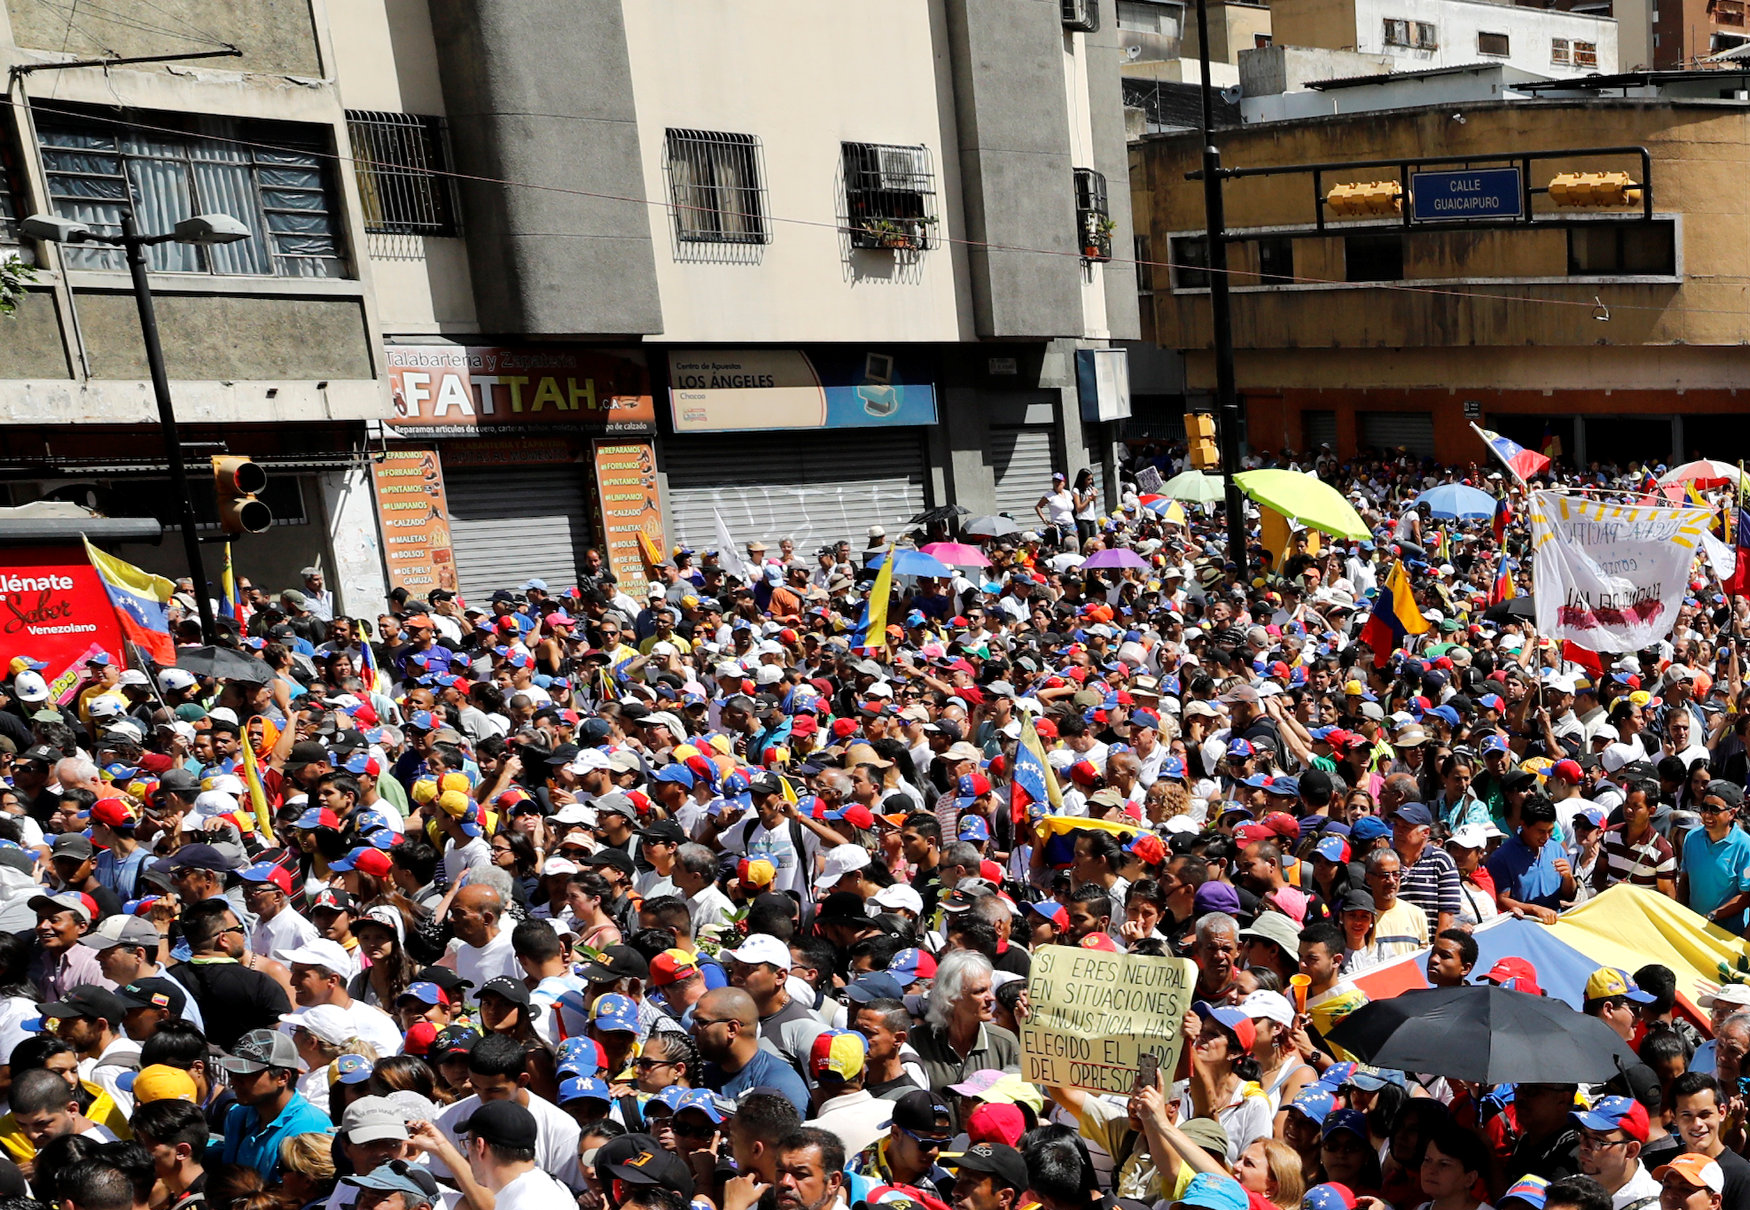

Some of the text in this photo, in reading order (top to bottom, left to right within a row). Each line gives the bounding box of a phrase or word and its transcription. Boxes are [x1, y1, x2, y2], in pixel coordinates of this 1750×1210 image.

[1450, 180, 1481, 192] CALLE
[1434, 196, 1500, 211] GUAICAIPURO
[676, 362, 742, 371] Centro de Apuestas
[678, 371, 774, 389] LOS ÁNGELES
[394, 425, 434, 434] Reparamos
[614, 422, 623, 431] de
[624, 421, 648, 431] calzado
[604, 446, 640, 454] REPARAMOS
[385, 452, 424, 460] EPARAMOS
[607, 462, 640, 470] FORRAMOS
[387, 485, 422, 493] PINTAMOS
[610, 493, 643, 501] LIMPIAMOS
[390, 501, 428, 510] LIMPIAMOS
[614, 508, 642, 517] CALZADO
[393, 518, 426, 527] CALZADO
[396, 535, 427, 543] MALETAS
[398, 550, 425, 559] BOLSOS
[619, 556, 628, 564] DE
[401, 566, 410, 575] DE
[411, 566, 425, 574] PIEL
[4, 588, 73, 634] Sabor
[27, 622, 97, 635] Venezolano
[1071, 957, 1119, 982] ERES
[1124, 964, 1187, 990] NEUTRAL
[1029, 978, 1178, 1017] EN SITUACIONES
[1025, 1005, 1176, 1042] DE INJUSTICIA, HAS
[1024, 1031, 1091, 1061] ELEGIDO
[1104, 1040, 1127, 1065] EL
[1031, 1057, 1061, 1083] DEL
[576, 1077, 594, 1091] NY
